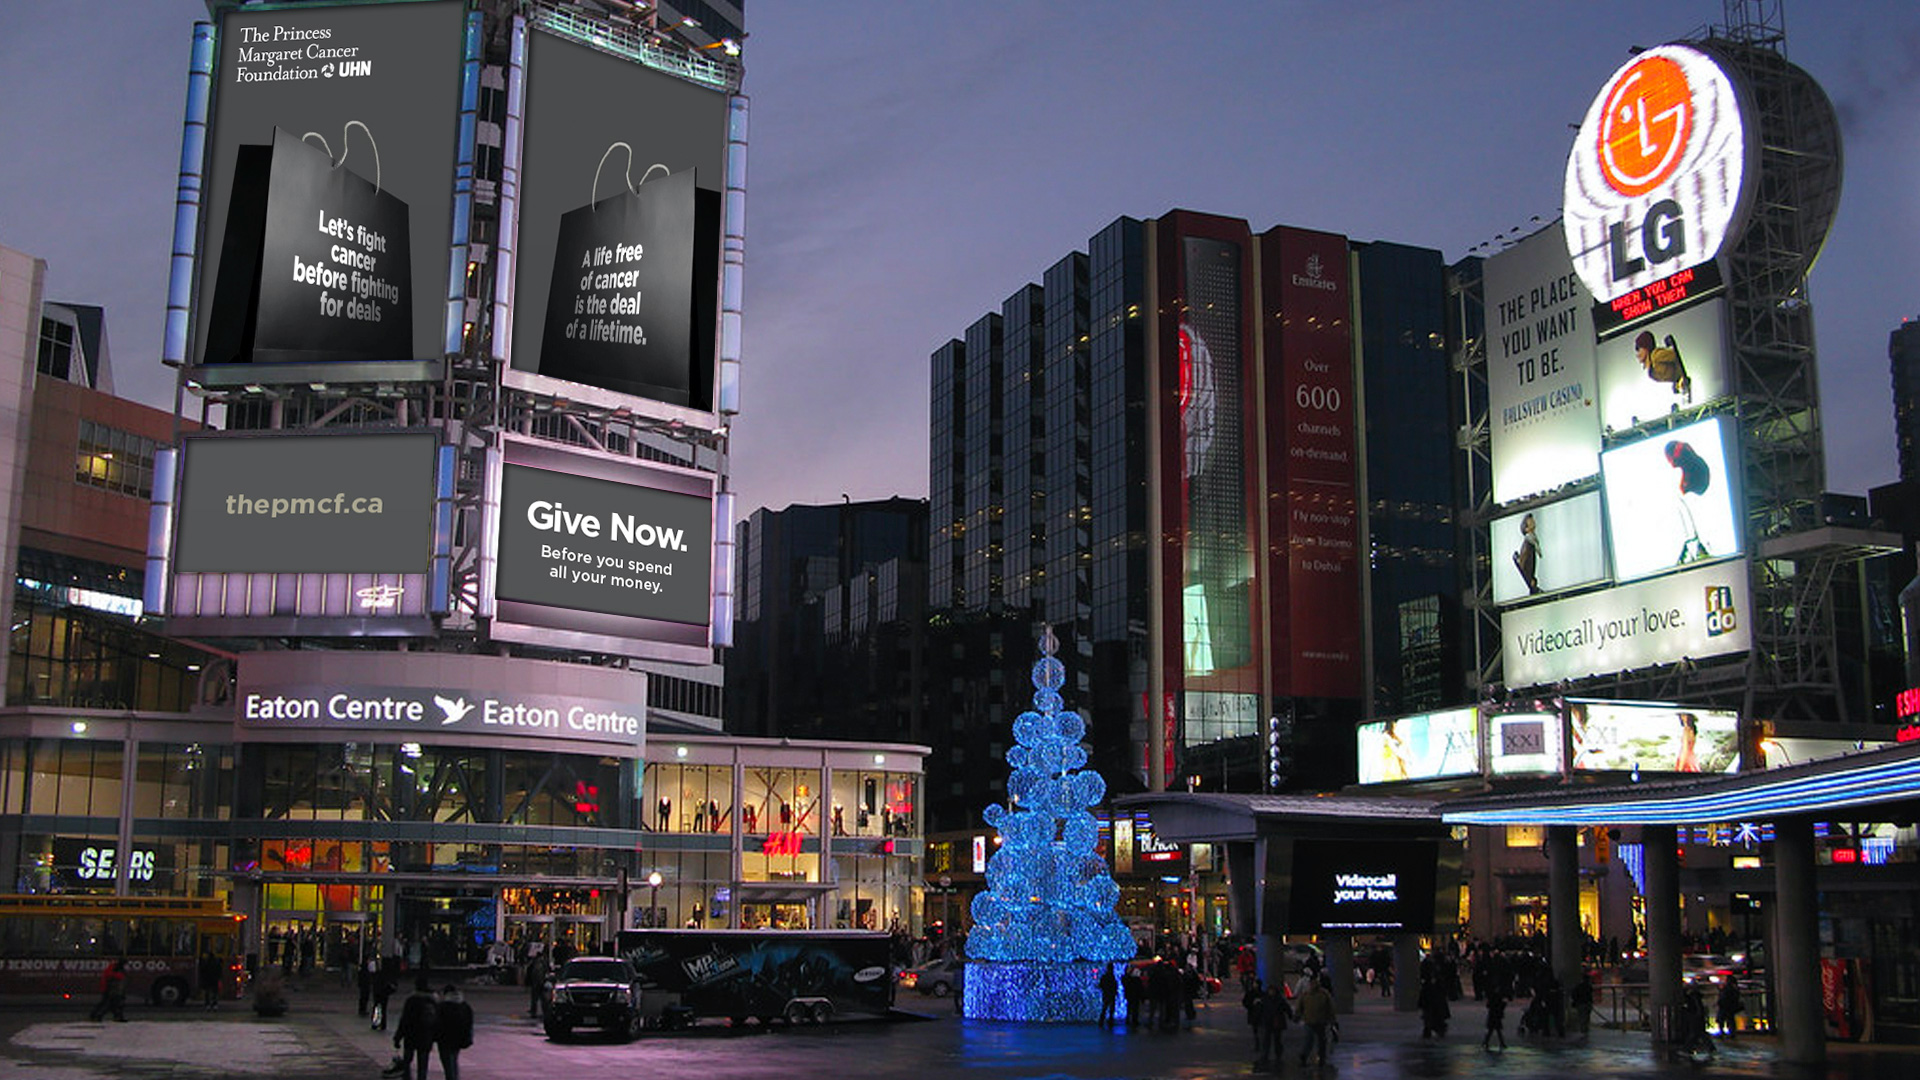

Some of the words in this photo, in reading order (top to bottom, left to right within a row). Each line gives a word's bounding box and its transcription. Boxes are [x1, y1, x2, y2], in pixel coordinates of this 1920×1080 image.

[240, 27, 270, 43] The
[273, 26, 332, 42] Princess
[238, 47, 302, 67] Margaret
[306, 44, 359, 59] Cancer
[236, 65, 318, 82] Foundation
[338, 60, 372, 77] UHN
[357, 225, 386, 253] fight
[1609, 198, 1686, 282] LG
[331, 244, 376, 272] cancer
[581, 250, 591, 268] A
[593, 246, 612, 266] life
[615, 243, 644, 264] free
[292, 255, 348, 290] before
[351, 271, 399, 305] fighting
[580, 270, 594, 290] of
[594, 270, 640, 290] cancer
[1611, 290, 1642, 312] WHEN
[1643, 280, 1668, 298] YOU
[1669, 268, 1694, 288] CAN
[320, 291, 344, 317] for
[346, 296, 382, 322] deals
[574, 294, 584, 314] is
[586, 294, 607, 315] the
[610, 291, 642, 315] deal
[1498, 294, 1525, 326] THE
[1531, 272, 1577, 313] PLACE
[1622, 299, 1653, 320] SHOW
[1655, 285, 1687, 306] THEM
[566, 318, 579, 339] of
[579, 323, 588, 340] a
[589, 319, 647, 345] lifetime.
[1502, 328, 1534, 358] YOU
[1536, 307, 1578, 344] WANT
[1517, 358, 1535, 386] TO
[1541, 348, 1564, 378] BE.
[1296, 384, 1340, 412] 600
[226, 493, 383, 518] thepmcf.ca
[527, 500, 600, 538] Give
[610, 512, 688, 552] Now.
[541, 544, 592, 564] Before
[596, 555, 624, 569] you
[628, 563, 672, 576] spend
[550, 565, 567, 579] all
[572, 570, 606, 584] your
[610, 575, 663, 594] money.
[1518, 618, 1594, 656] Videocall
[1598, 616, 1639, 650] your
[1642, 608, 1686, 633] love.
[246, 694, 320, 719] Eaton
[328, 694, 424, 721] Centre
[483, 700, 560, 728] Eaton
[568, 706, 638, 735] Centre
[1506, 733, 1540, 748] XXI
[1336, 874, 1396, 887] Videocall
[1334, 890, 1366, 904] your
[1367, 887, 1398, 900] love.
